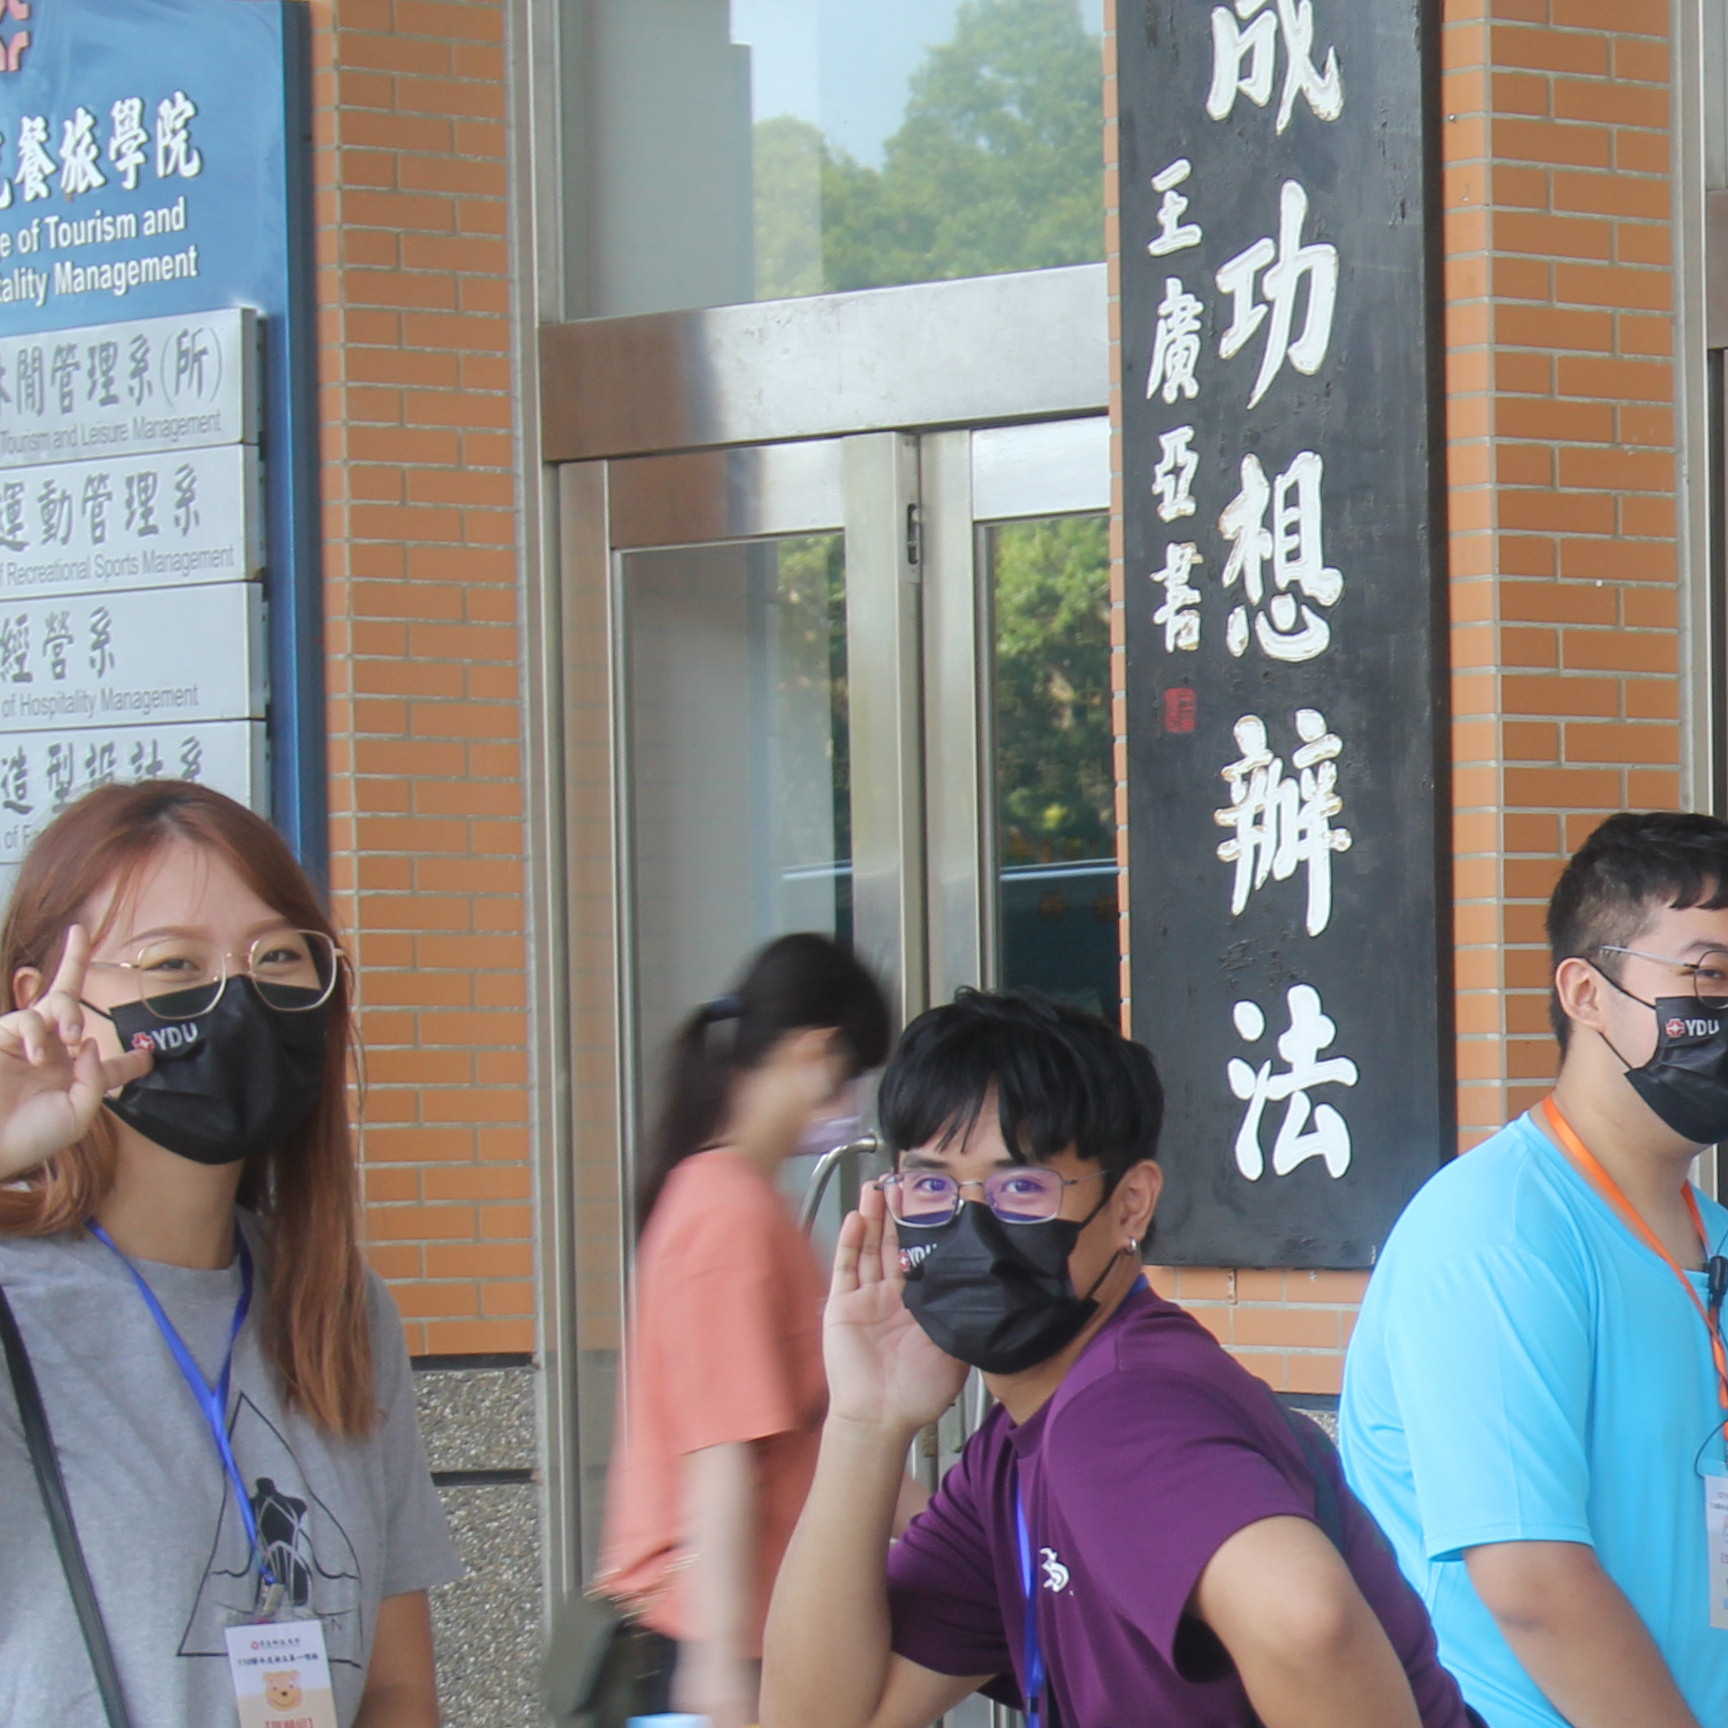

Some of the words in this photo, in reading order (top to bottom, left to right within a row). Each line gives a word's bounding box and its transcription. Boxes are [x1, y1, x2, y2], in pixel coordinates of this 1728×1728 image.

[0, 90, 204, 208] 餐旅學院
[18, 218, 42, 254] of
[45, 209, 137, 249] Tourism
[143, 195, 187, 237] and
[54, 245, 199, 297] Management
[52, 423, 79, 450] and
[81, 417, 129, 446] Leisure
[132, 410, 223, 442] Management
[7, 555, 92, 587] Recreational
[94, 552, 140, 582] Sports
[142, 544, 235, 577] Management
[0, 606, 116, 683] 經營系
[3, 697, 16, 718] of
[19, 690, 96, 721] Hospitality
[100, 683, 200, 716] Management
[152, 1021, 199, 1053] YDU
[1685, 1018, 1720, 1037] YDU
